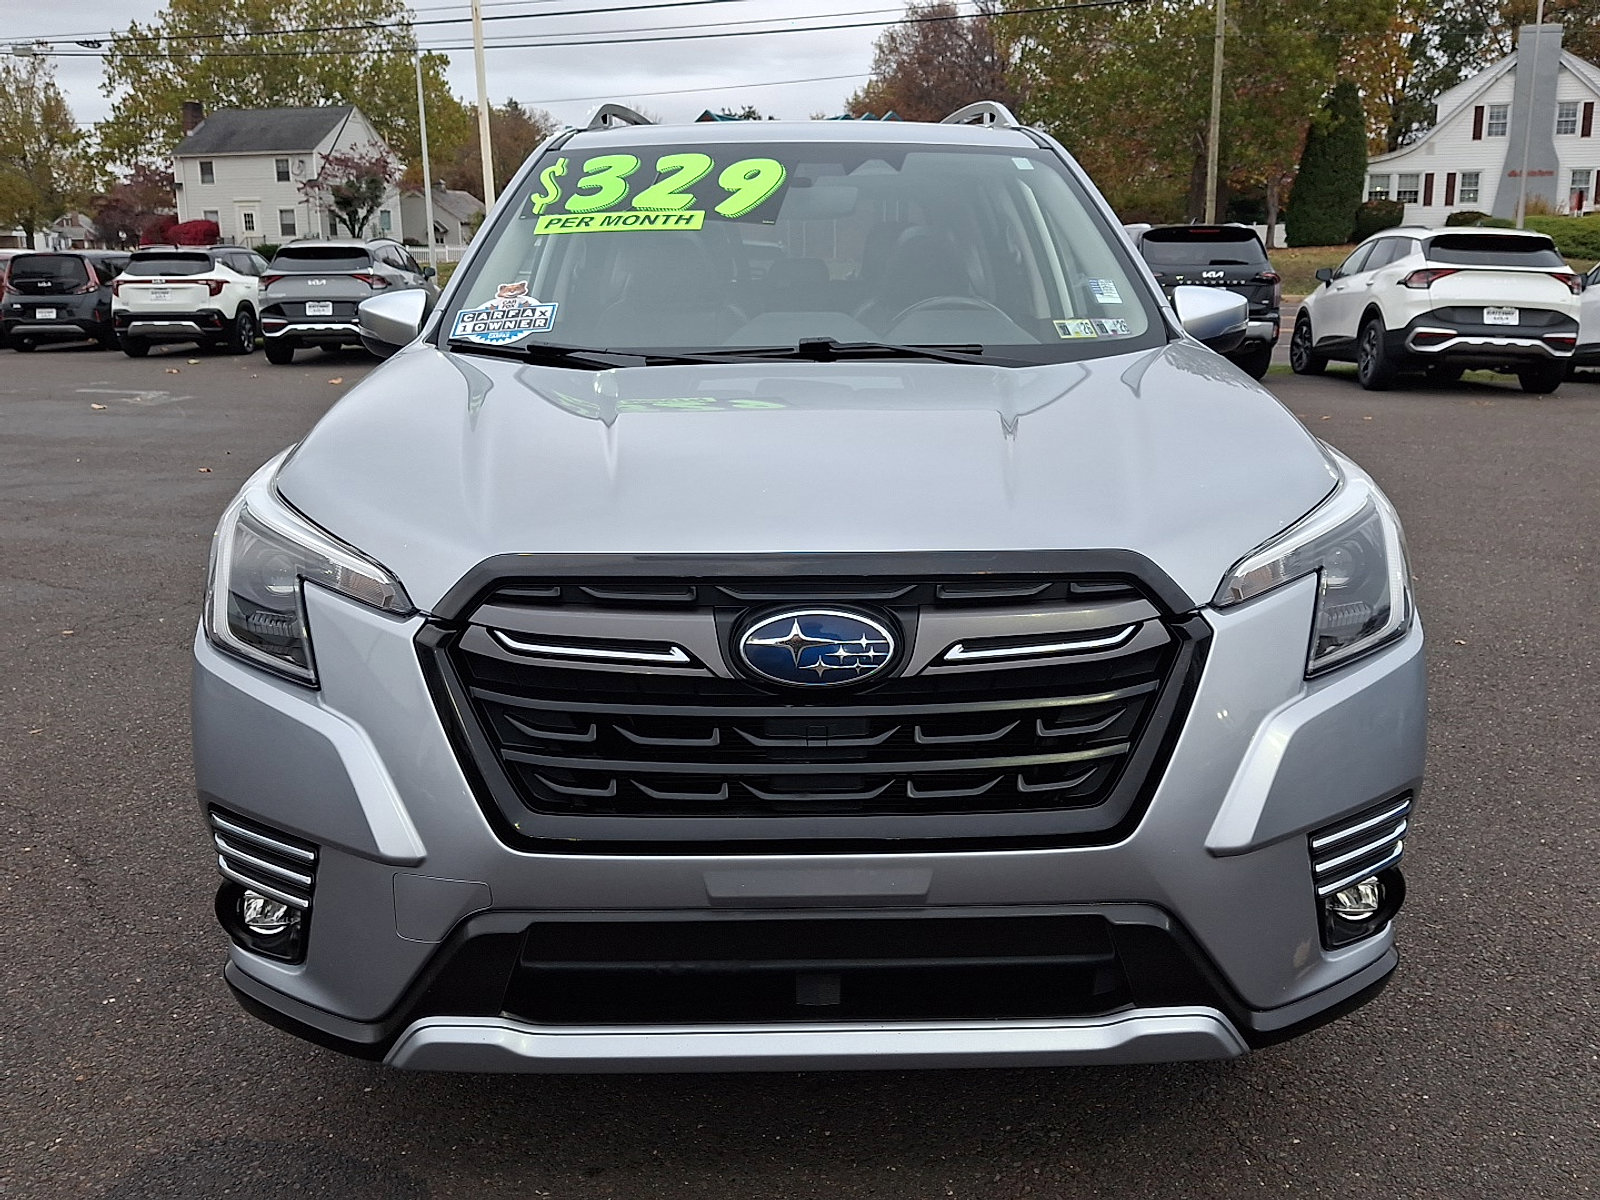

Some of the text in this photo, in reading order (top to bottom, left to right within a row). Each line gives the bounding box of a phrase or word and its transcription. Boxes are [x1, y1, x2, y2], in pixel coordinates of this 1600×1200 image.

[531, 153, 786, 218] $329
[544, 213, 695, 230] PER MONTH
[463, 309, 548, 322] CARFAX
[460, 318, 546, 333] 1 OWNER
